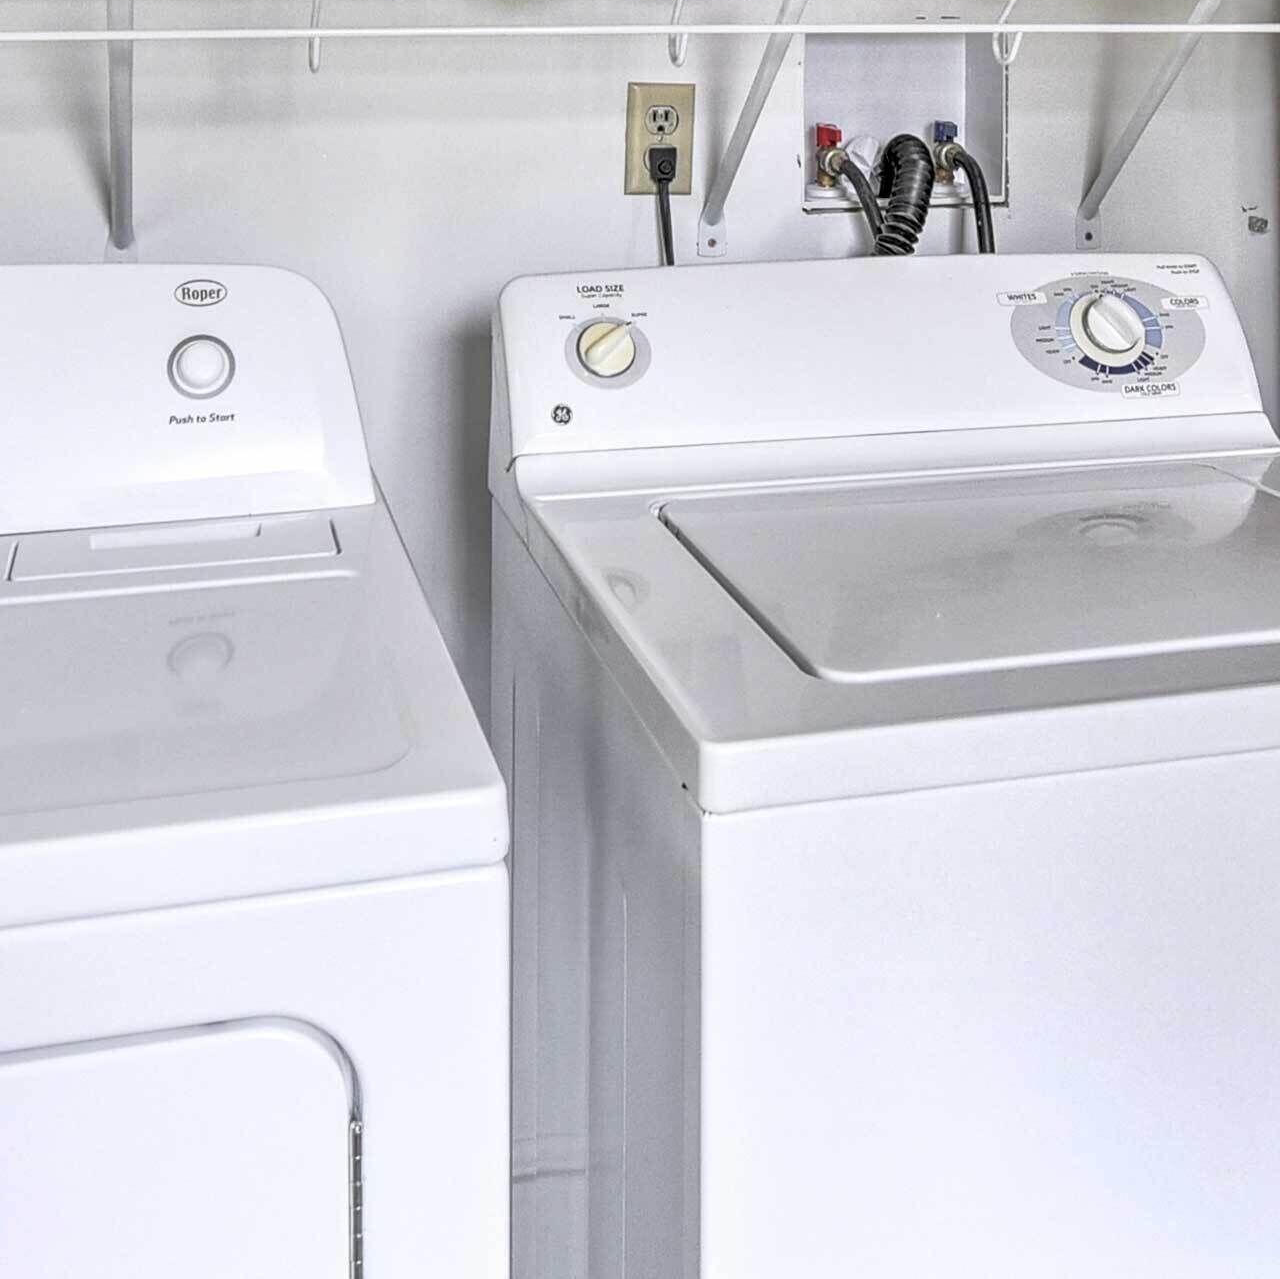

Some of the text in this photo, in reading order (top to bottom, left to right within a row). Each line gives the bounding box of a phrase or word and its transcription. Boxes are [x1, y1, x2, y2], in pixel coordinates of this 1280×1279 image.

[577, 284, 625, 294] LOAD SIZE
[181, 287, 223, 302] Roper
[1007, 292, 1037, 301] WHITES
[1170, 298, 1200, 306] COLORS
[1124, 383, 1177, 394] DARK COLORS
[168, 412, 236, 425] Push to Start
